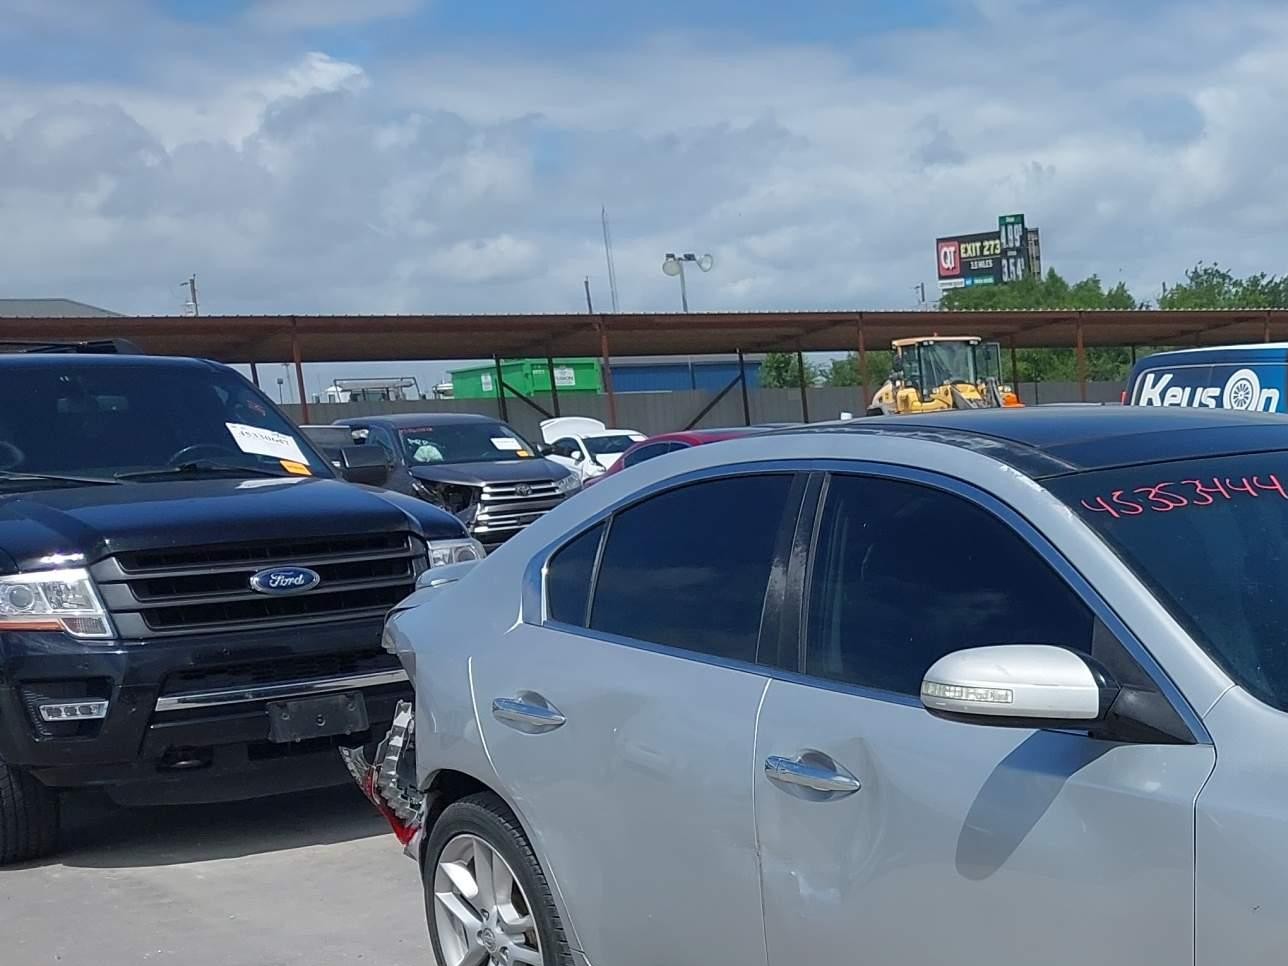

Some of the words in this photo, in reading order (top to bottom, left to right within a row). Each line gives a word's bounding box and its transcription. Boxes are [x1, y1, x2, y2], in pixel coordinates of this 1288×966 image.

[941, 246, 956, 269] QT
[960, 242, 981, 258] EXIT
[983, 240, 1001, 256] 273
[1081, 474, 1288, 518] 45353444
[269, 572, 305, 588] Ford
